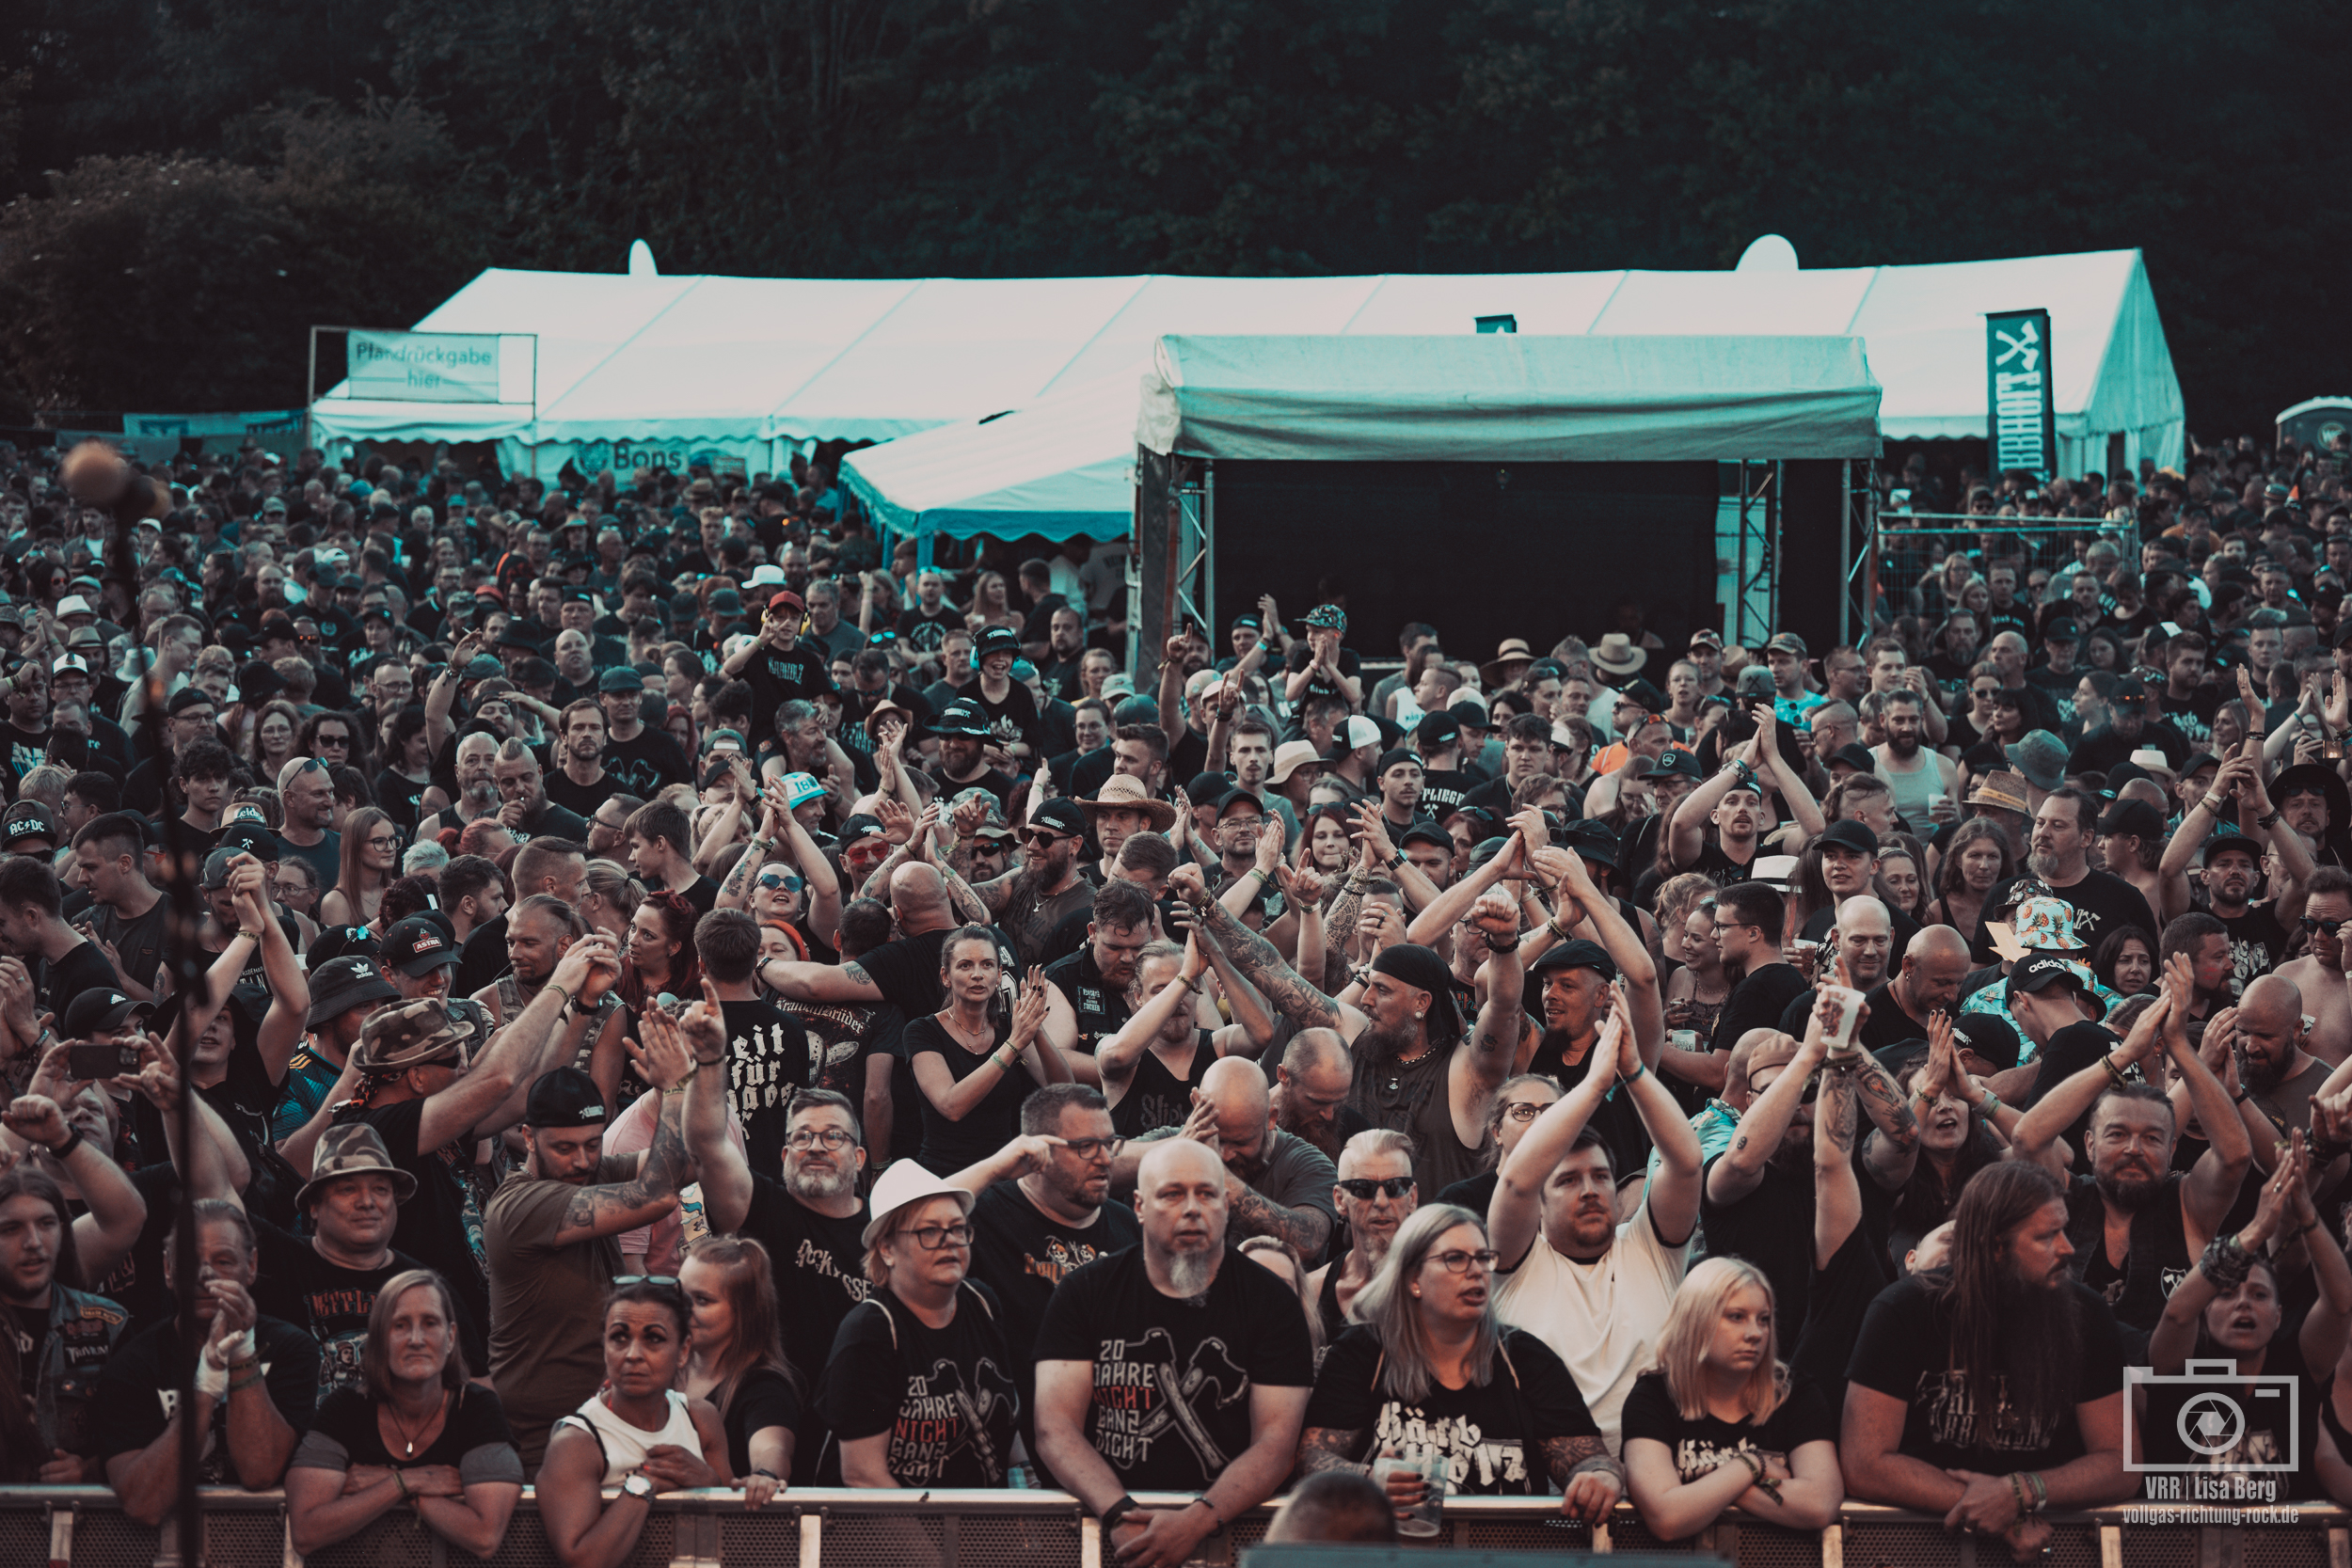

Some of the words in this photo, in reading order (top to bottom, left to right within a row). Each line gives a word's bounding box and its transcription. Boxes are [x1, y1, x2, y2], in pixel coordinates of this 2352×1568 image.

[356, 341, 493, 370] Pfandrückgabe
[406, 370, 443, 388] hier
[613, 442, 683, 471] Bons
[416, 939, 440, 950] ASTRA
[729, 1022, 785, 1060] eit
[1100, 1339, 1125, 1361] 20
[908, 1375, 928, 1397] 20
[1093, 1361, 1155, 1387] JAHRE
[899, 1393, 958, 1420] JAHRE
[1094, 1386, 1155, 1410] NICHT
[895, 1417, 960, 1443] NICHT
[1096, 1404, 1140, 1434] GANZ
[890, 1436, 948, 1461] GANZ
[1095, 1428, 1153, 1463] DICHT
